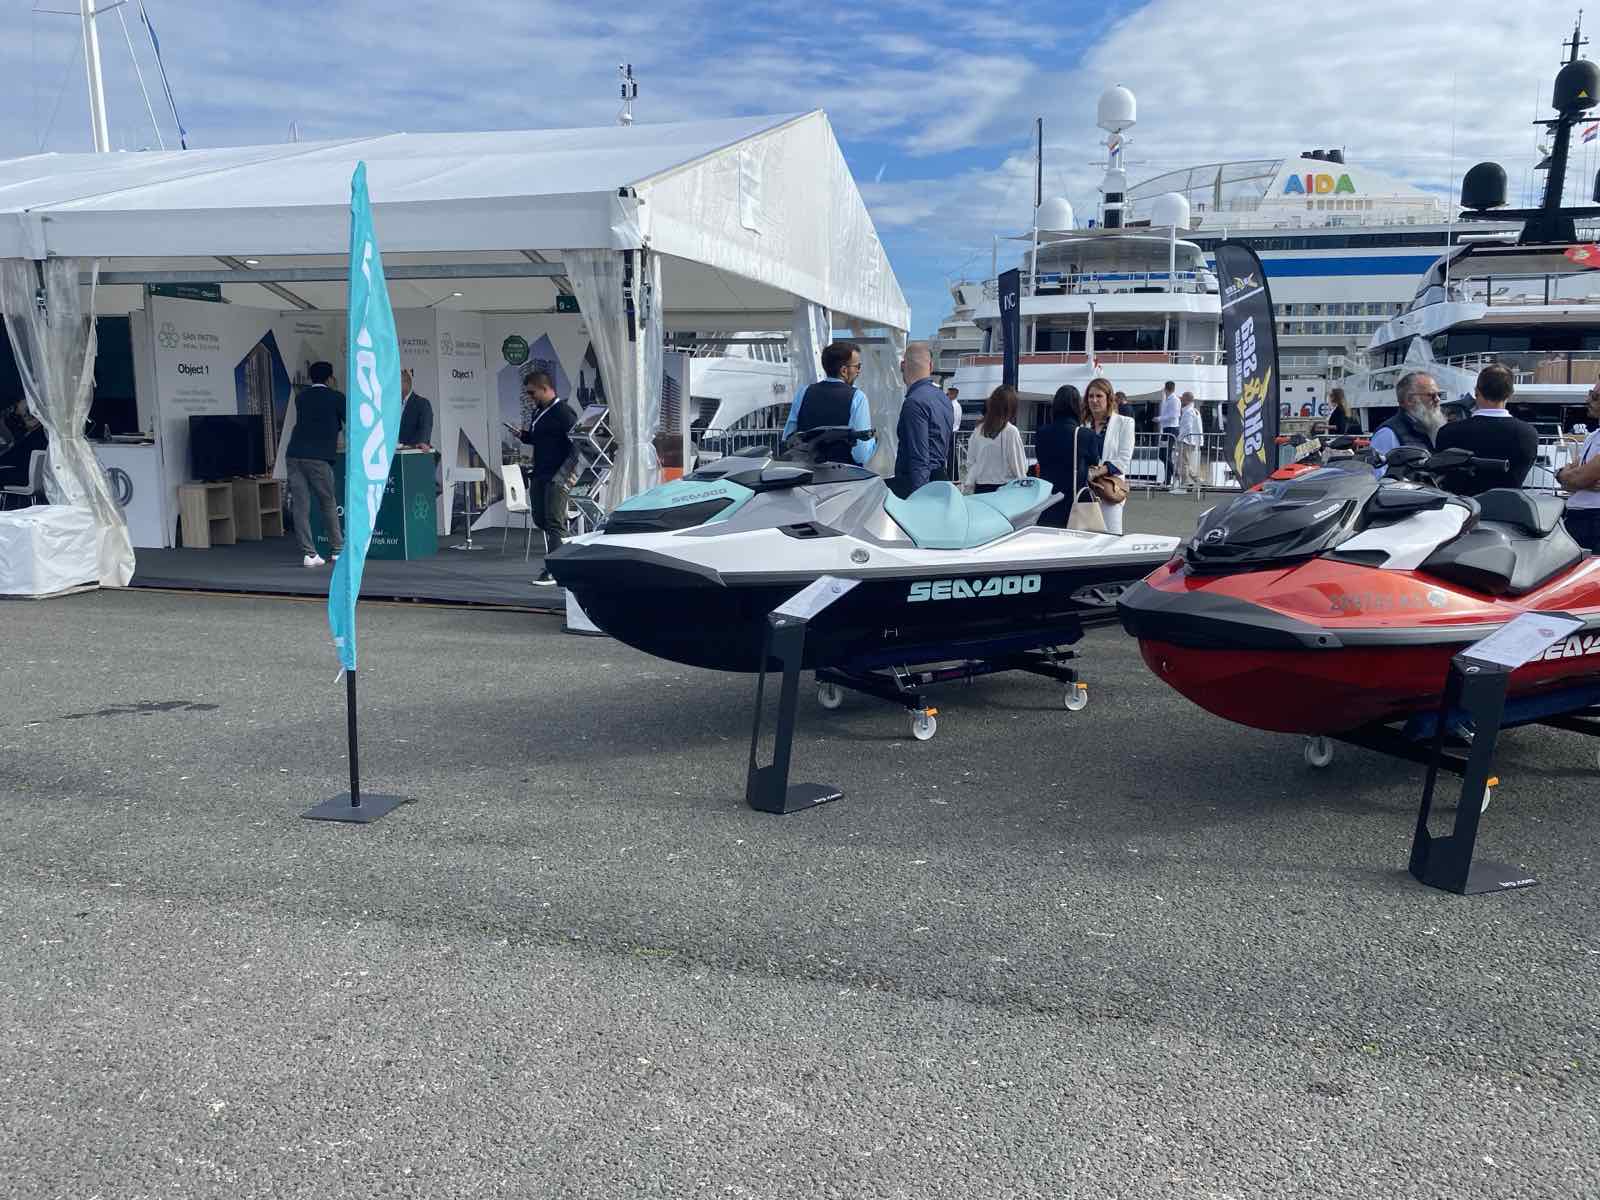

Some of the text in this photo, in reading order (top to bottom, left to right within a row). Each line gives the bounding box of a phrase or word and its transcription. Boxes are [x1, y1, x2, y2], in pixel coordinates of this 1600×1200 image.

[1283, 173, 1356, 194] AIDA
[177, 363, 209, 376] Object 1
